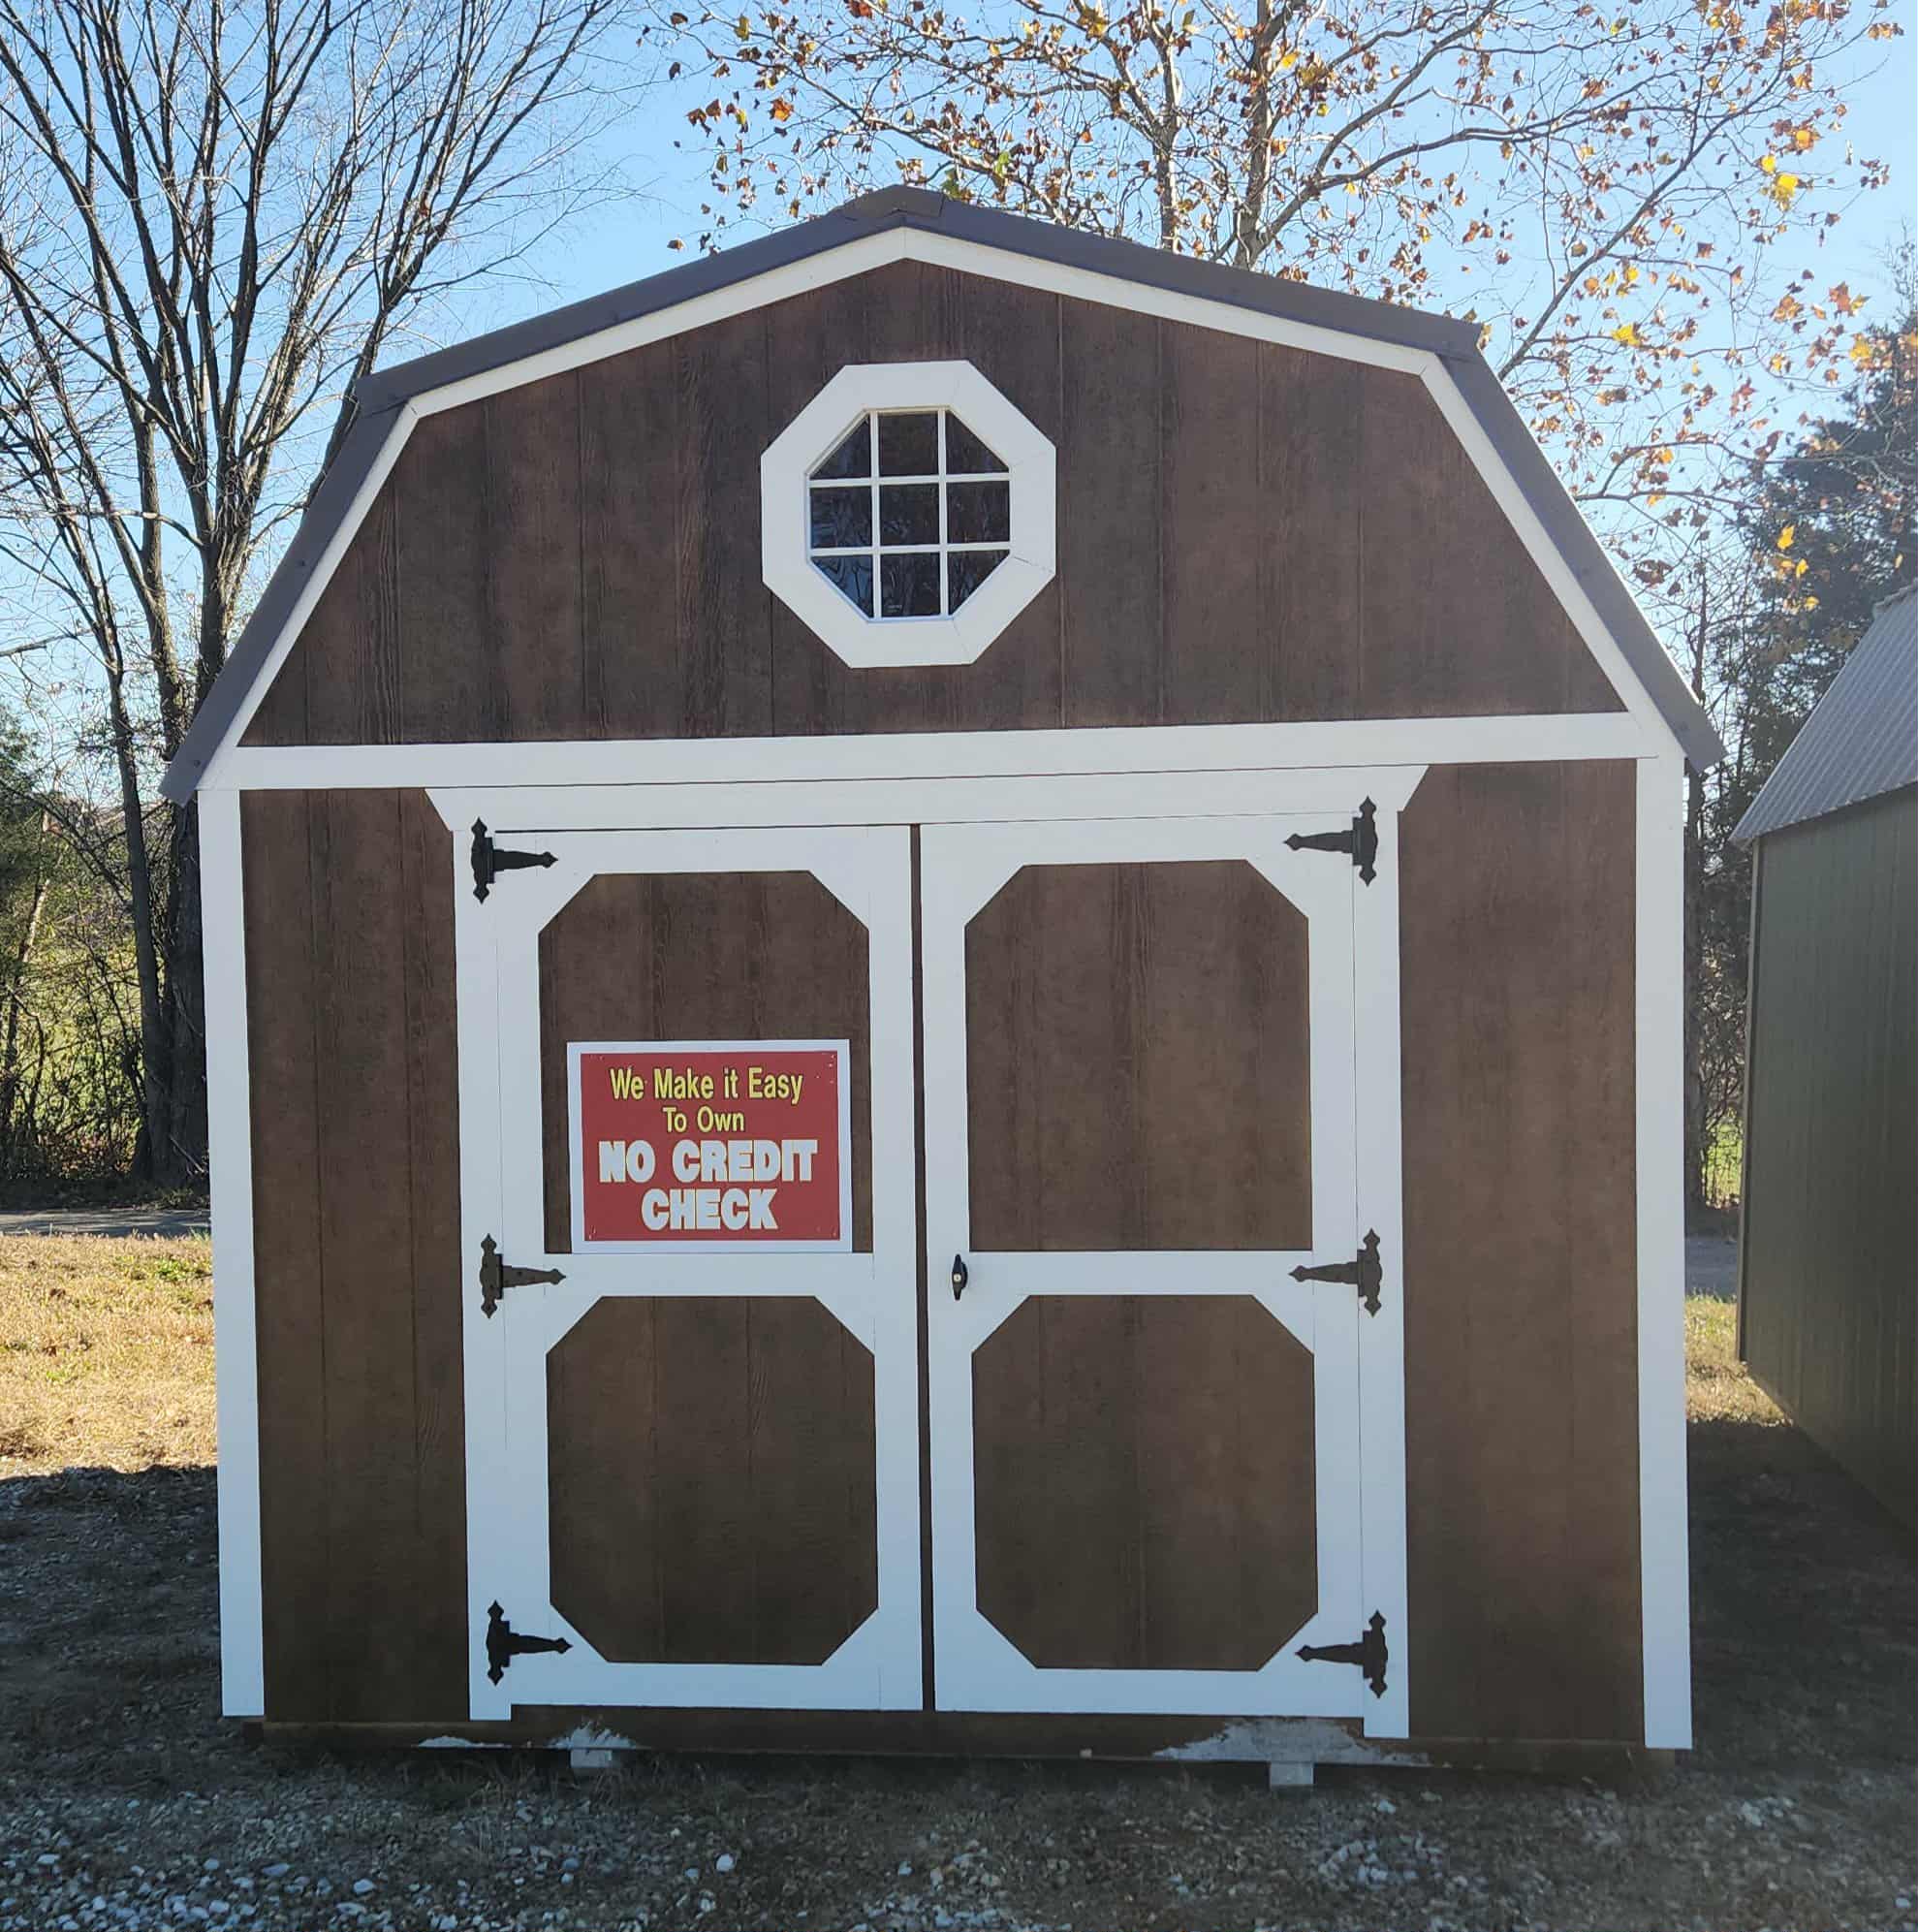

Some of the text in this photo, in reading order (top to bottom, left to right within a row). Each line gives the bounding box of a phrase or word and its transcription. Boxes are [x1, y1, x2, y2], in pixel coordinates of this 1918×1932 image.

[610, 1066, 803, 1105] We Make it Easy
[663, 1105, 744, 1133] To Own
[599, 1139, 818, 1184] NO CREDIT
[641, 1188, 778, 1231] CHECK
